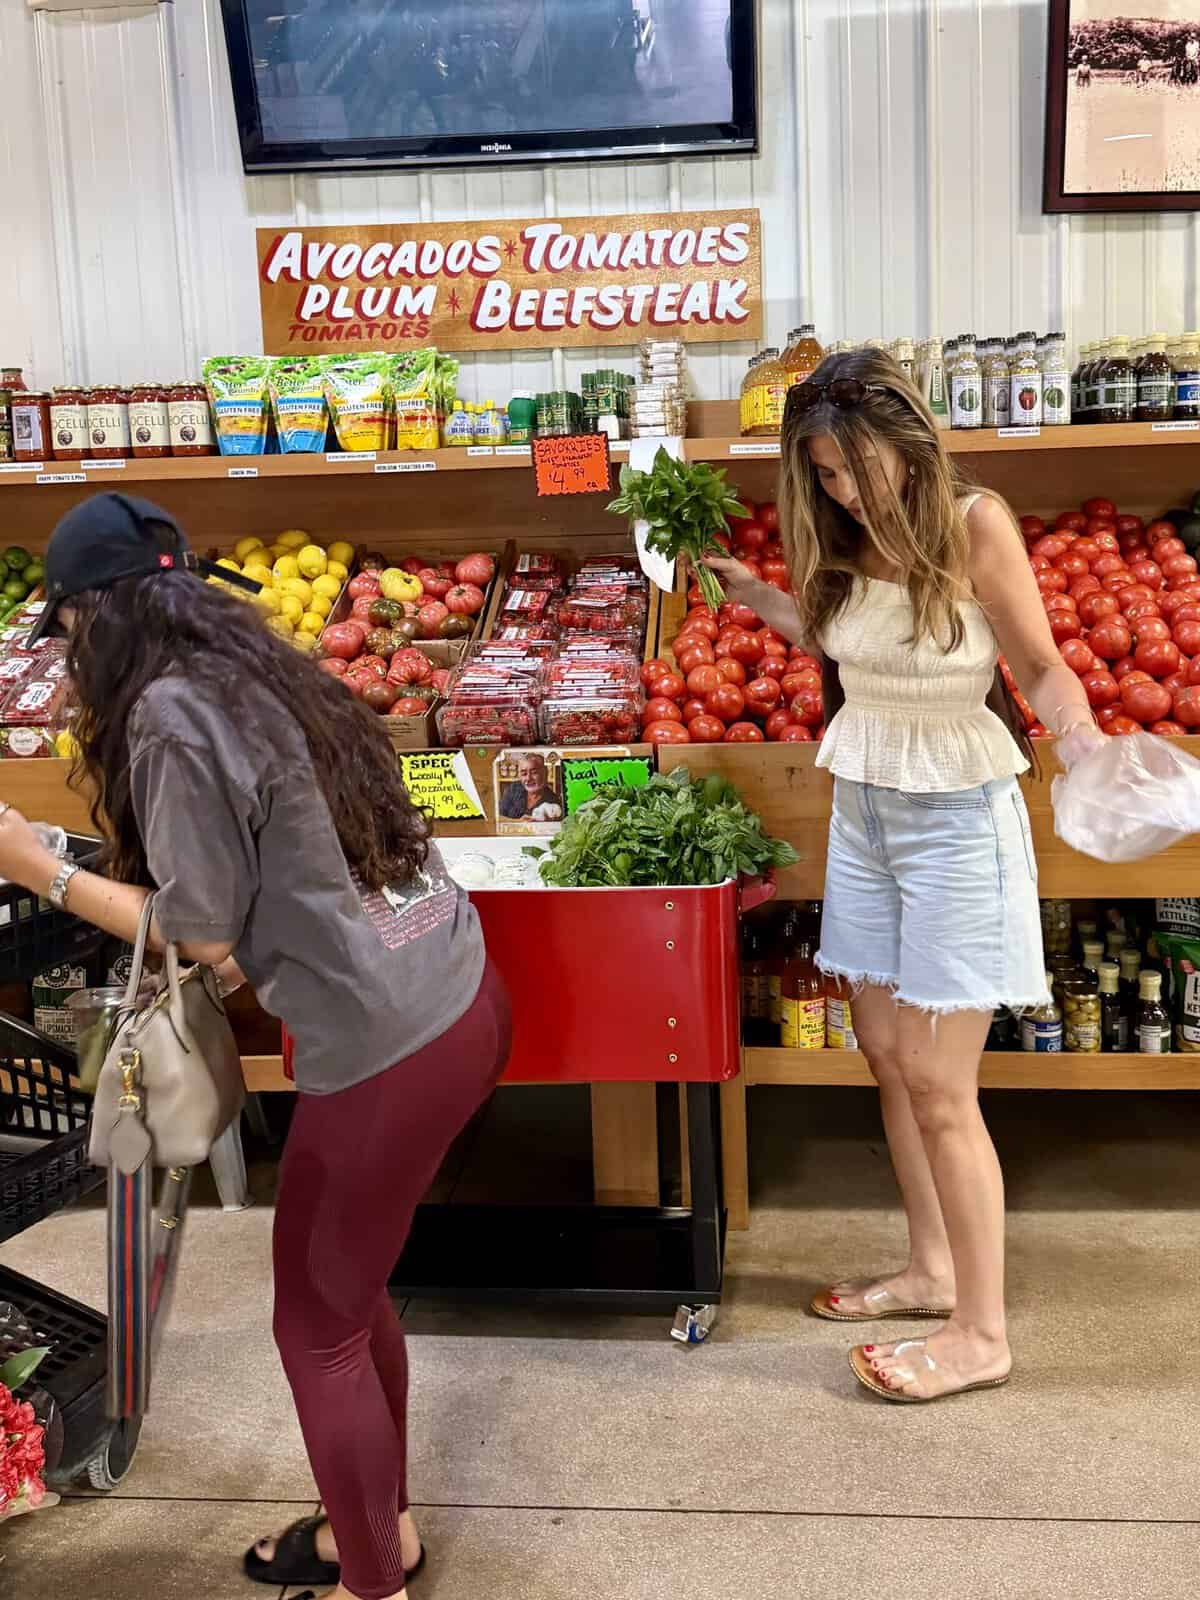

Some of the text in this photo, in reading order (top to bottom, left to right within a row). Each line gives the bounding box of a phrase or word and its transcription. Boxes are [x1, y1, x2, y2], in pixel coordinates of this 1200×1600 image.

[480, 142, 512, 153] INSIGNIA
[263, 222, 750, 283] AVOCADOS TOMATOES
[299, 278, 750, 333] PLUM BEEFSTEAK
[287, 320, 431, 343] TOMATOES
[217, 406, 260, 415] GLUTEN FREE
[278, 403, 321, 413] GLUTEN FREE
[338, 402, 383, 413] GLUTEN FREE
[131, 415, 166, 426] OCELLI
[409, 771, 443, 786] Locally
[568, 765, 598, 781] Local
